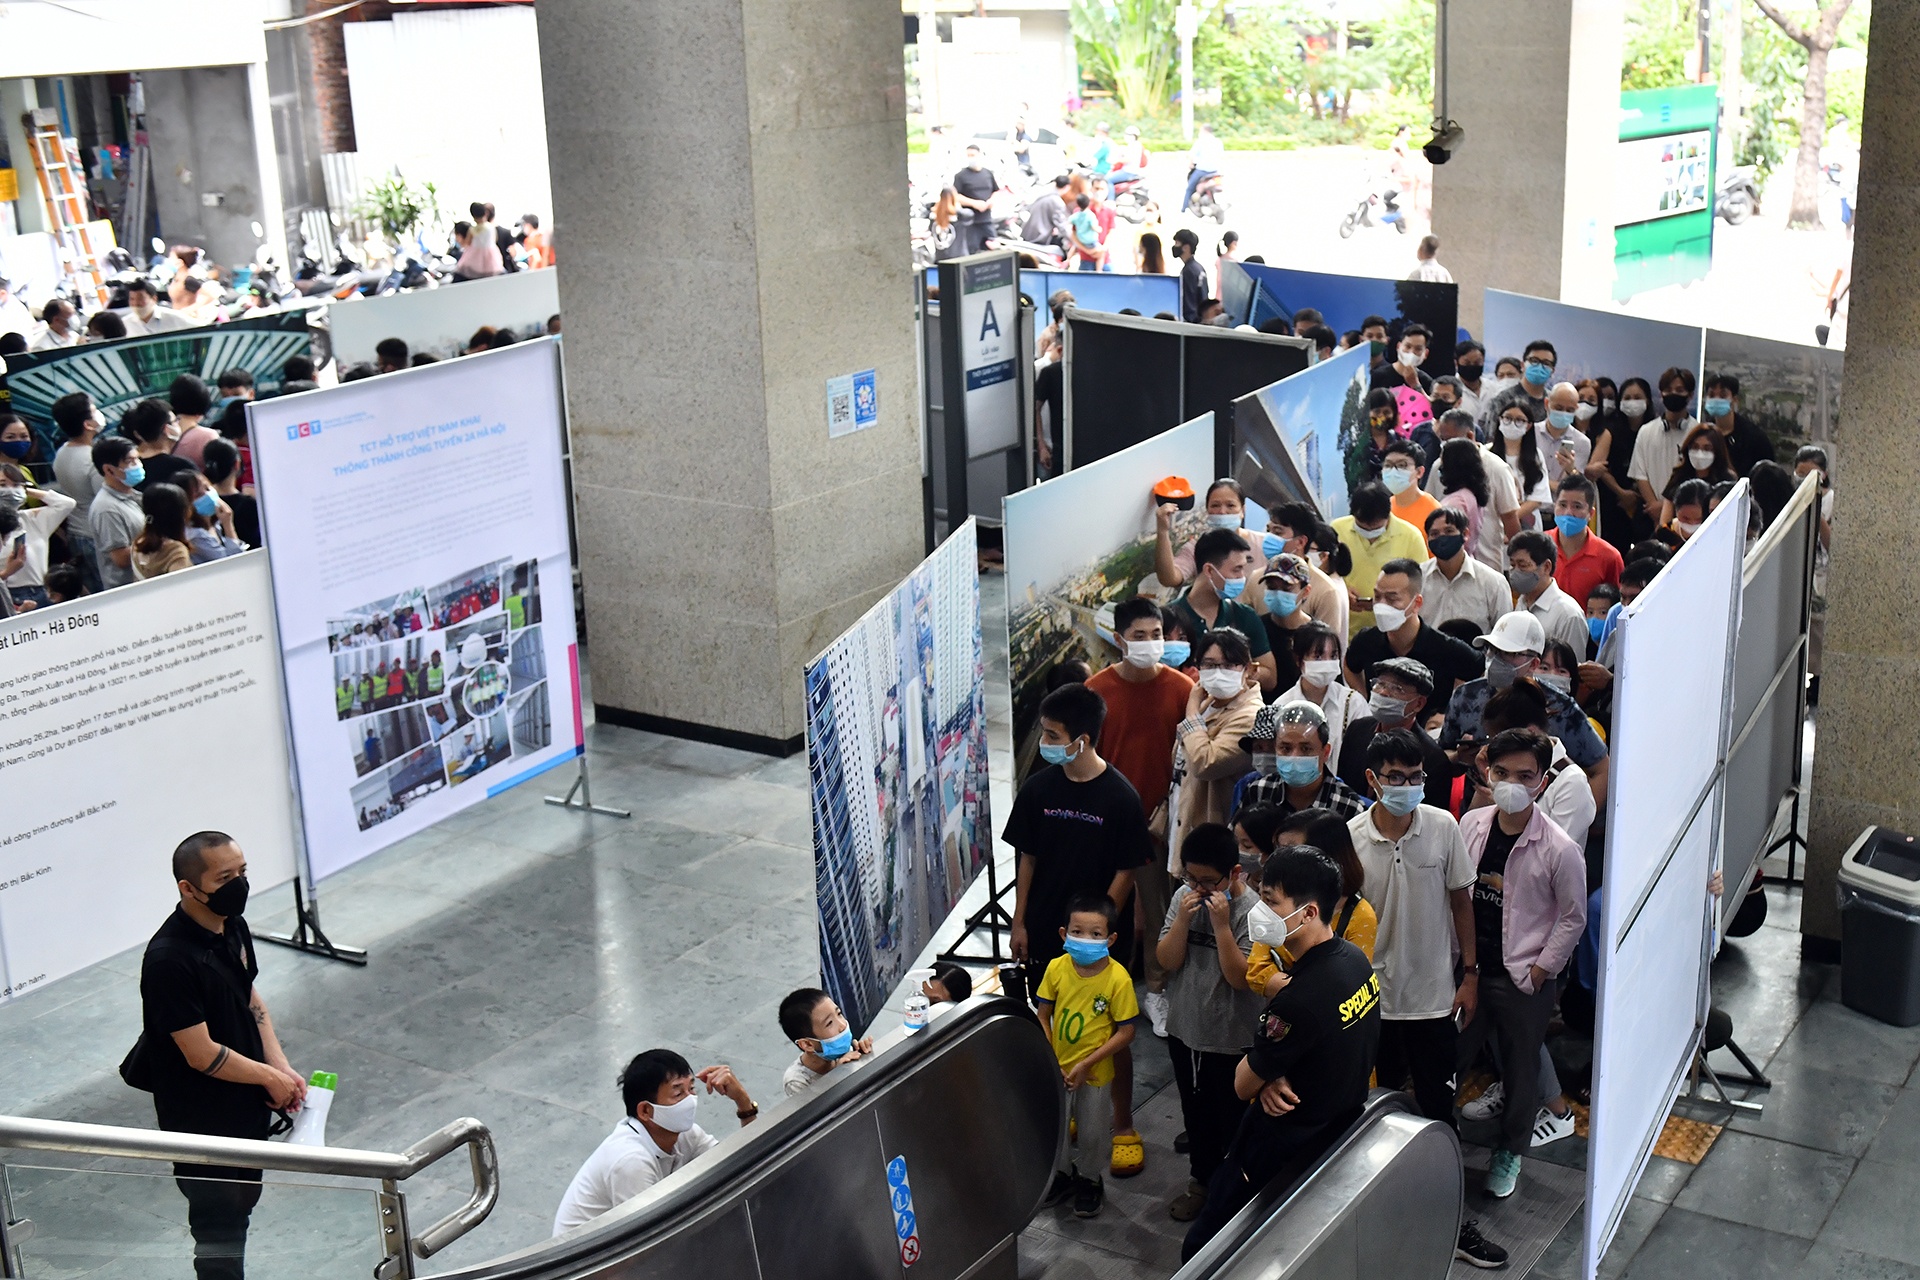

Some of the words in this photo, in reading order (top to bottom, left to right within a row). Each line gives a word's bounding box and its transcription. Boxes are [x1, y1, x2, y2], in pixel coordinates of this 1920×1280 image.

[980, 300, 1001, 341] A
[287, 420, 321, 440] TCT
[360, 441, 377, 453] TCT
[11, 627, 39, 646] Linh
[49, 620, 65, 635] Hà
[67, 613, 100, 630] Đông
[22, 686, 45, 698] Thanh
[45, 679, 65, 691] Xuân
[65, 676, 75, 686] và
[75, 672, 86, 682] Hà
[143, 653, 152, 662] ga
[32, 670, 47, 681] giao
[48, 662, 69, 674] thông
[70, 656, 90, 668] thành
[105, 647, 116, 657] Hà
[49, 696, 61, 706] dài
[5, 736, 33, 750] khoảng
[61, 722, 76, 733] bao
[93, 713, 101, 722] 17
[153, 692, 169, 704] công
[27, 747, 45, 760] cũng
[54, 741, 66, 752] Dự
[151, 708, 167, 718] Nam
[220, 684, 238, 695] Trung
[13, 830, 32, 842] công
[32, 824, 49, 836] trình
[50, 816, 74, 829] đường
[86, 805, 100, 816] Bắc
[101, 800, 117, 810] Kinh
[20, 871, 35, 883] Bắc
[35, 865, 52, 877] Kinh
[1338, 982, 1372, 1022] SPECIAL
[1058, 1008, 1085, 1045] 10
